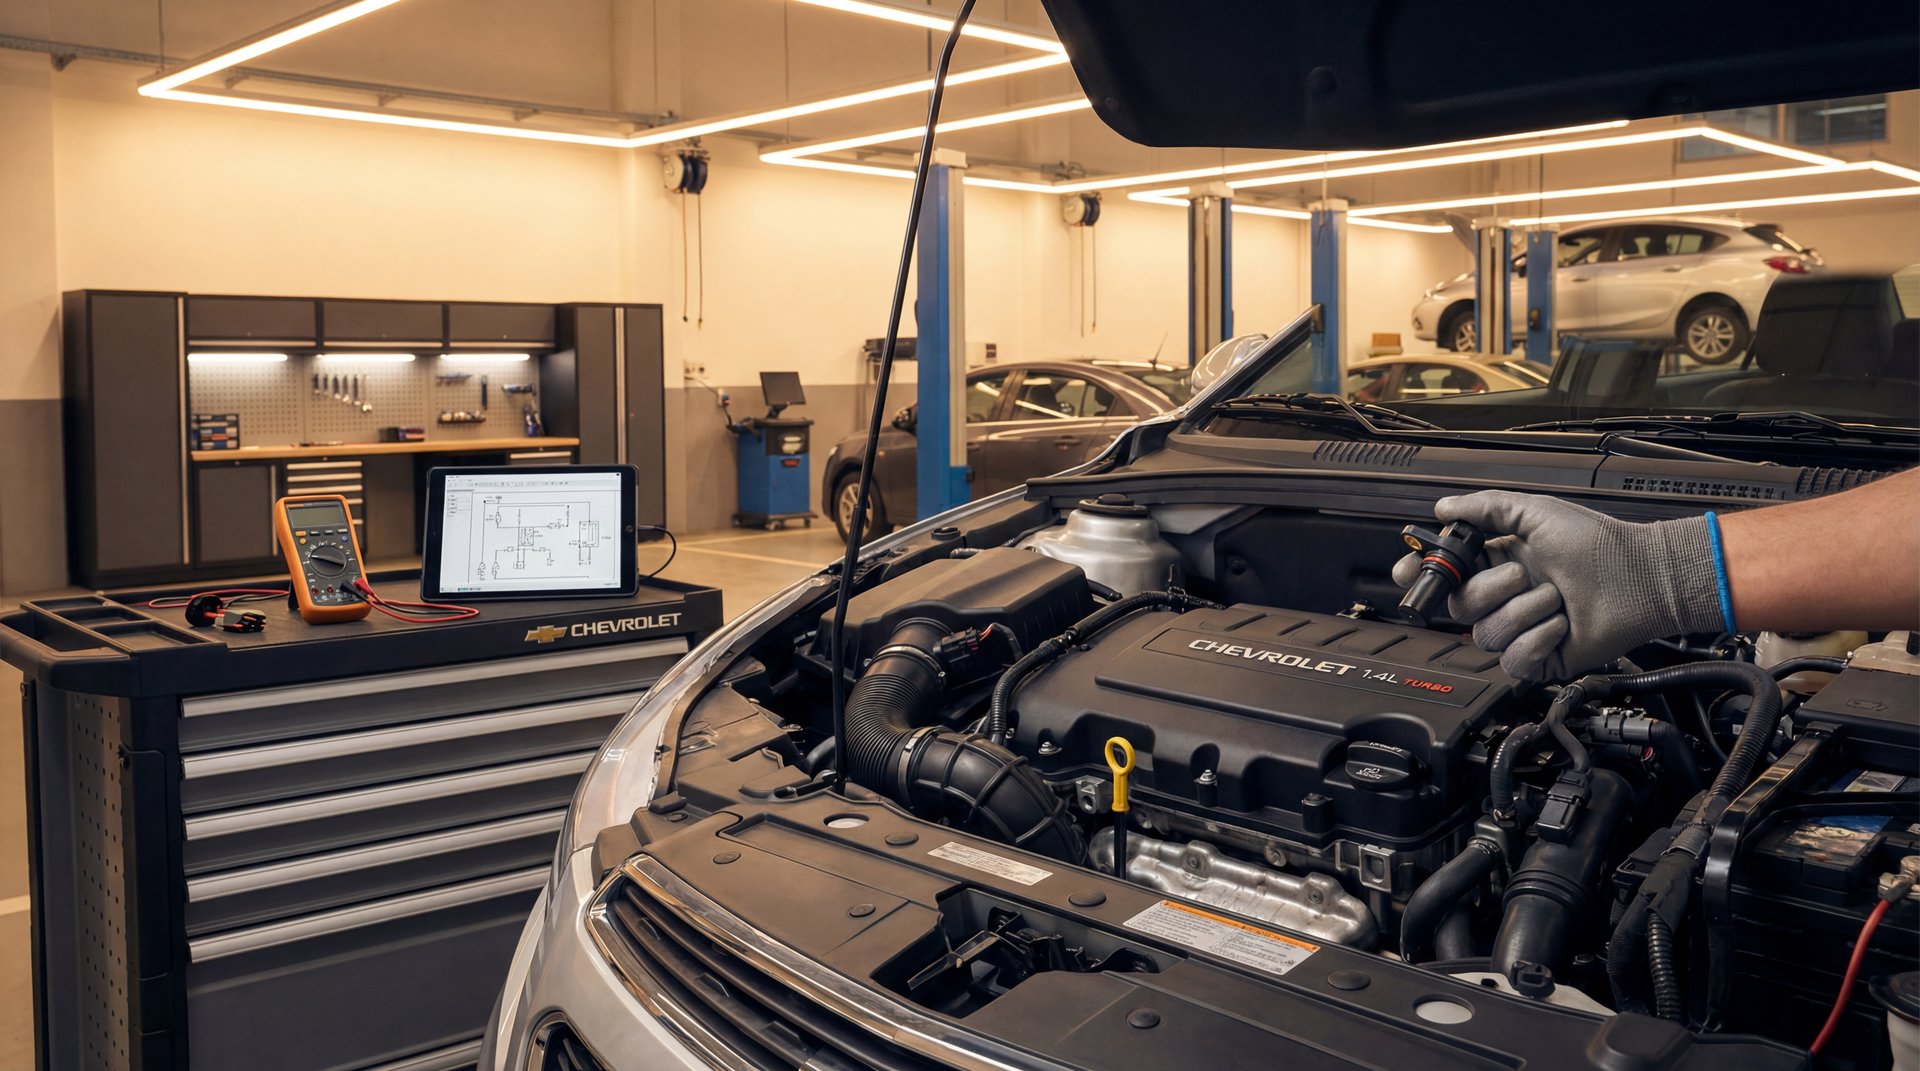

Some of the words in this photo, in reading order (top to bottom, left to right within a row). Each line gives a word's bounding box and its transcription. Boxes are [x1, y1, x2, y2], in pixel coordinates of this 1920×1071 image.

[571, 613, 682, 636] CHEVROLET
[1188, 639, 1357, 675] CHEVROLET
[1362, 669, 1398, 684] 1.4L
[1404, 678, 1453, 693] TURBO
